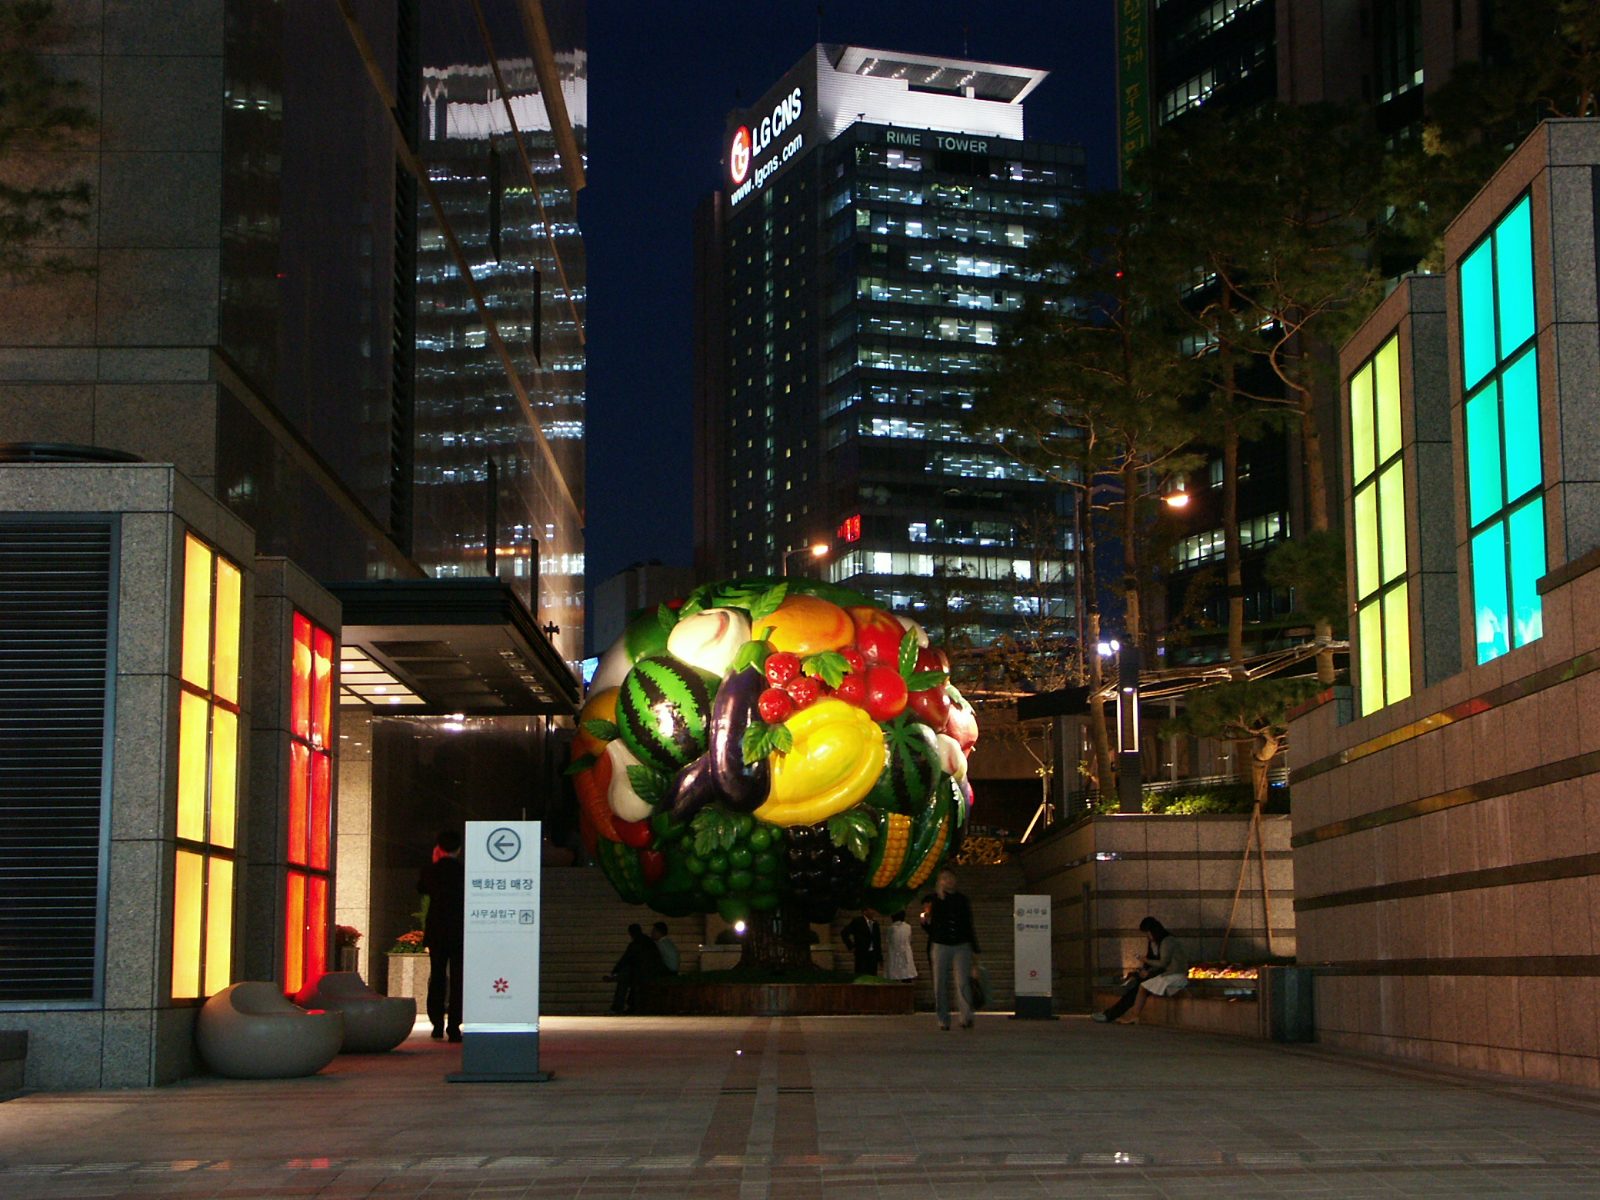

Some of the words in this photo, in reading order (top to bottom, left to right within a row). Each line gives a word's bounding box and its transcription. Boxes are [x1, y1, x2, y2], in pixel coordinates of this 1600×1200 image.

[752, 116, 771, 157] LG
[772, 87, 802, 138] CNS
[886, 131, 921, 147] RIME
[936, 136, 988, 153] TOWER
[731, 133, 803, 207] www.lgcns.com
[472, 878, 506, 891] 백화점
[510, 878, 534, 891] 매장
[470, 909, 516, 919] 사무실입구
